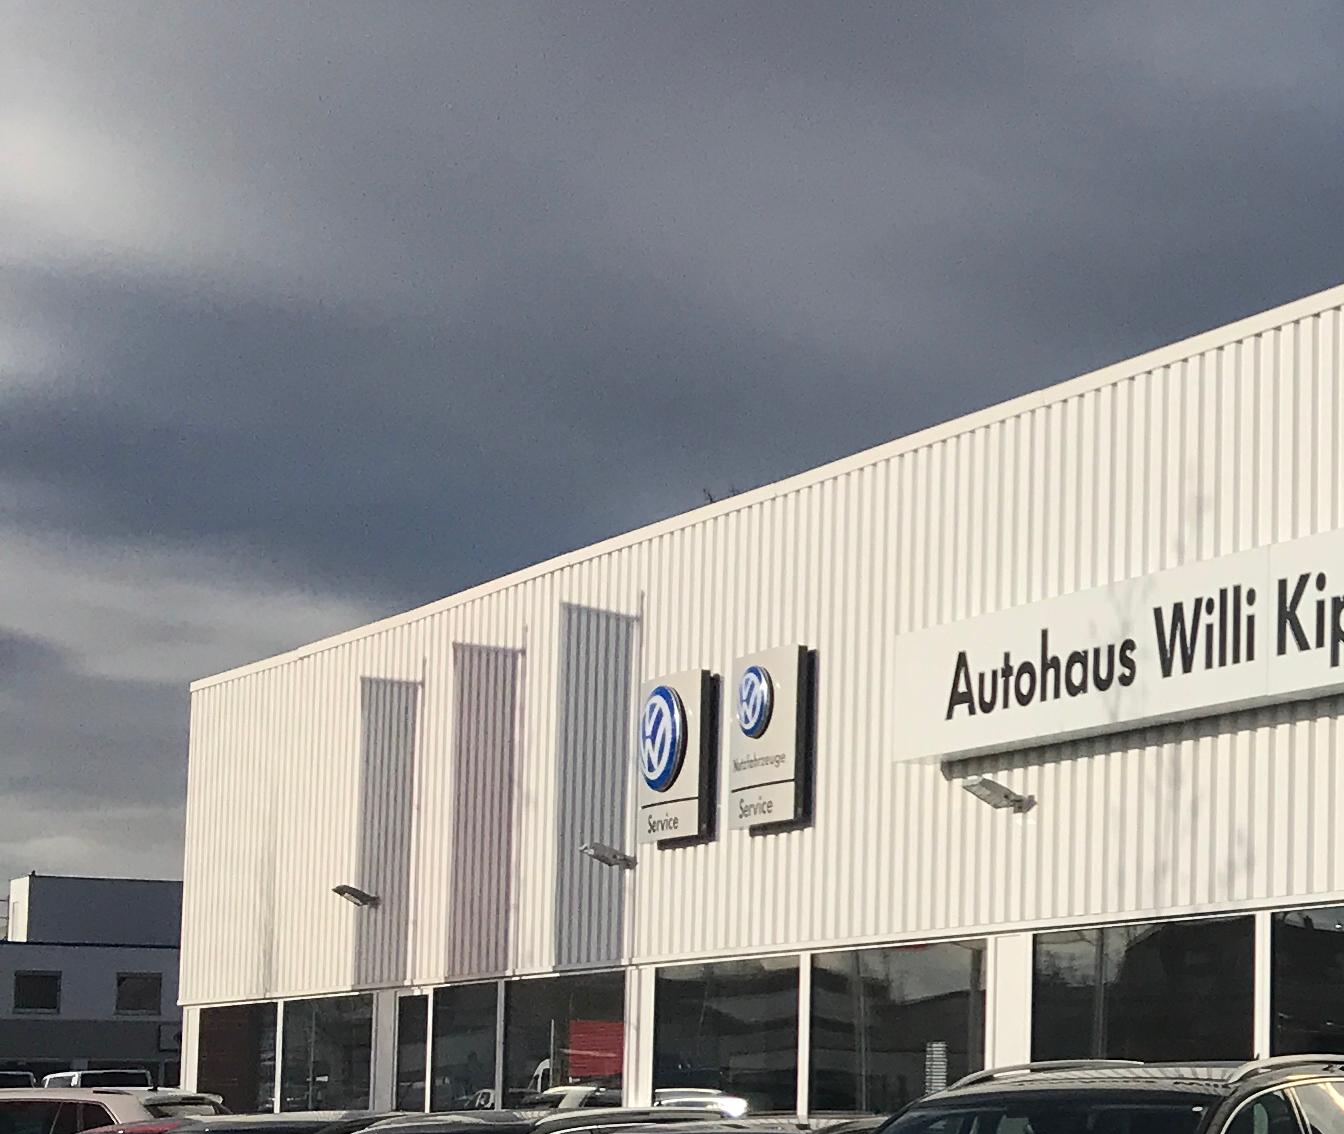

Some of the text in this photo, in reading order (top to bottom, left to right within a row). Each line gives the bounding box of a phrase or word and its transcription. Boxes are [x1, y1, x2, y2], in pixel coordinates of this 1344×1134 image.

[945, 628, 1137, 721] Autohaus
[1153, 583, 1257, 679] Willi
[732, 751, 786, 772] Nutzfahrzeuge
[738, 797, 774, 819] Service
[647, 812, 679, 834] Service
